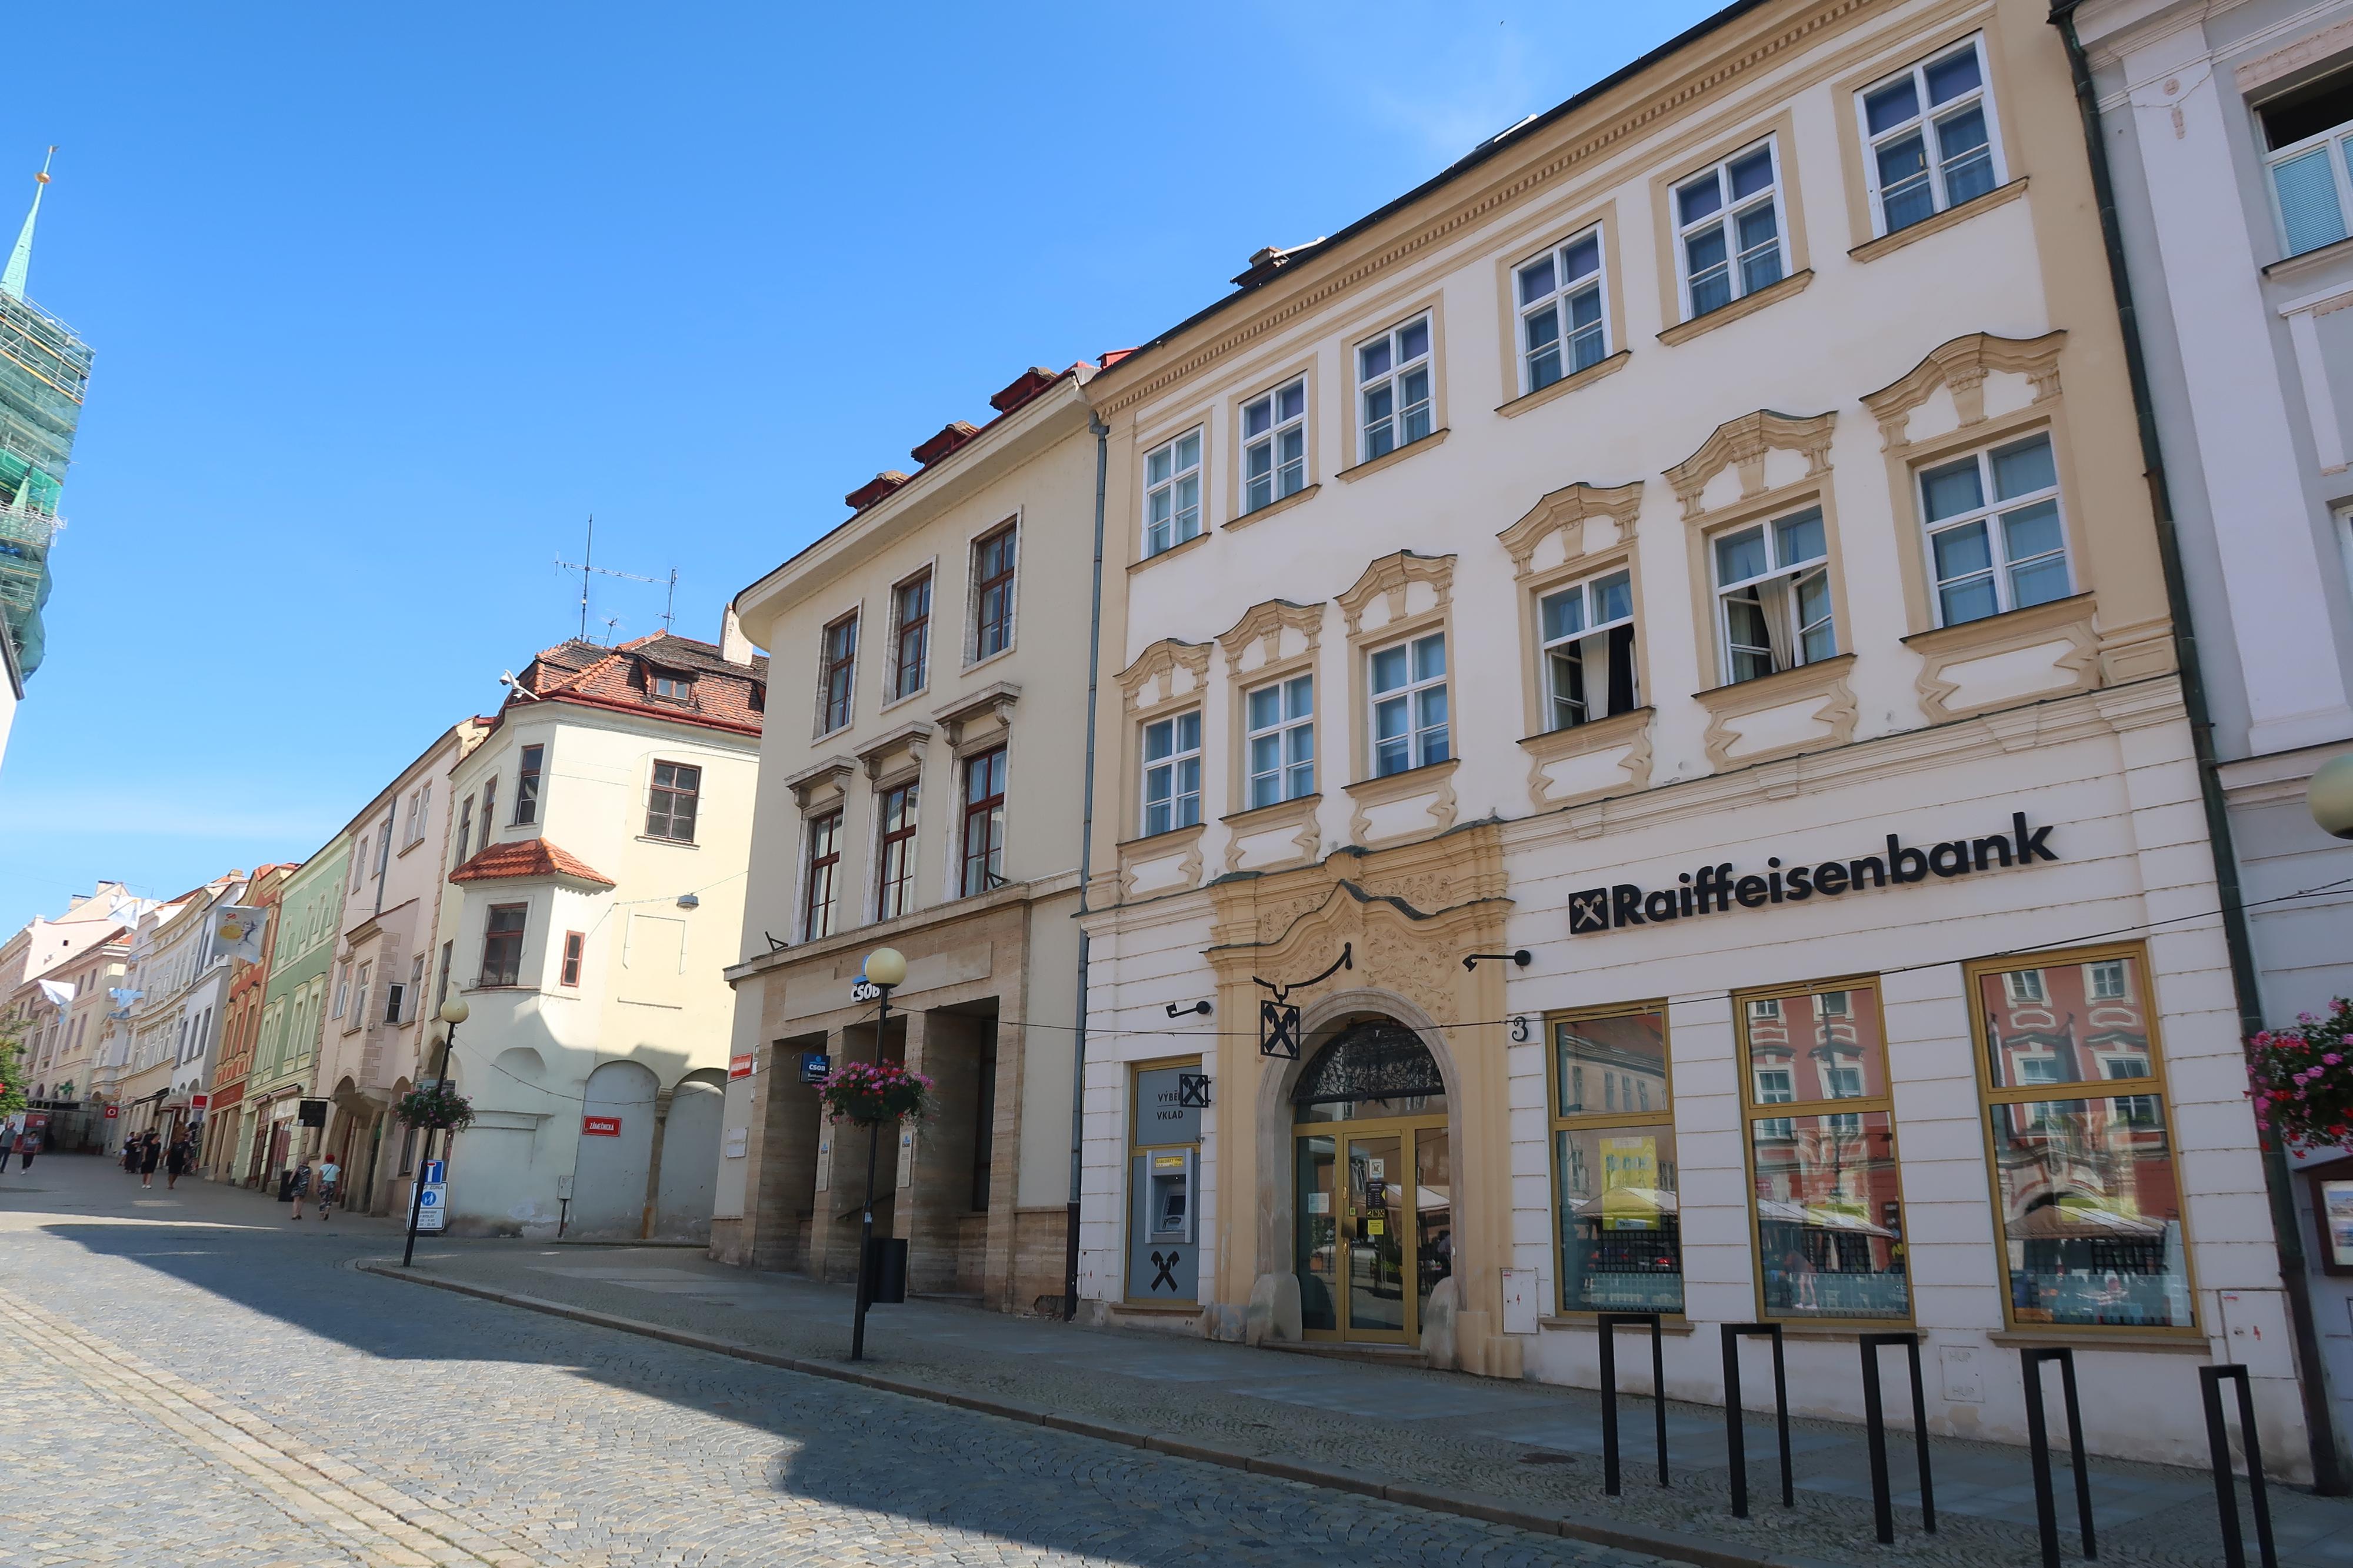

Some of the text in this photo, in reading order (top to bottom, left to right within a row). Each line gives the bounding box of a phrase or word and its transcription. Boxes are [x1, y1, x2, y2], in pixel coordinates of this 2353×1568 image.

[1612, 812, 2059, 928] Raiffeisenbank
[1512, 1016, 1528, 1042] 3
[1156, 1110, 1184, 1120] VKLAD
